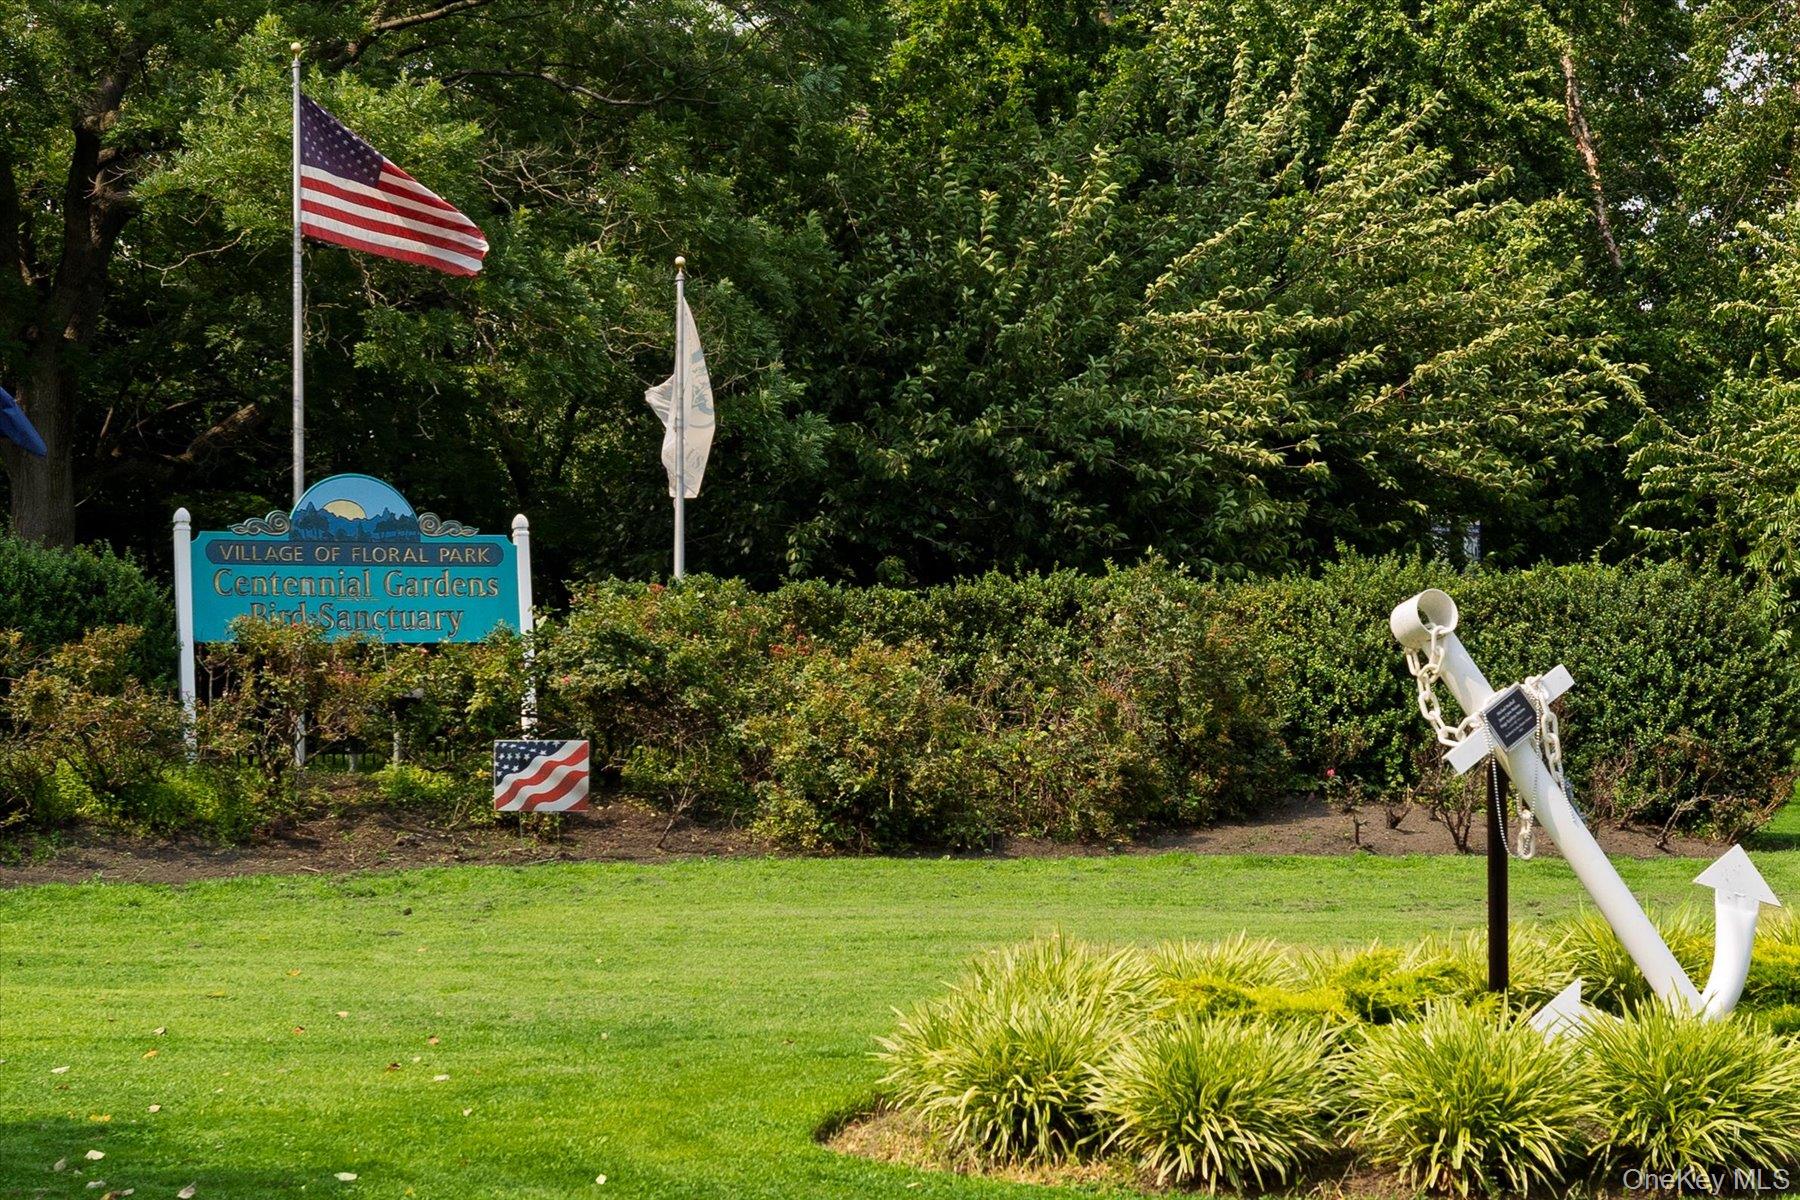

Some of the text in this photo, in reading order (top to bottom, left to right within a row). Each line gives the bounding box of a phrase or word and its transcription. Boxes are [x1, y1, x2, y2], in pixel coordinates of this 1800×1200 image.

[219, 544, 491, 564] VILLAGE OF FLORAL PARK
[213, 567, 500, 598] Centennial Gardens
[317, 601, 465, 638] Sanctuary
